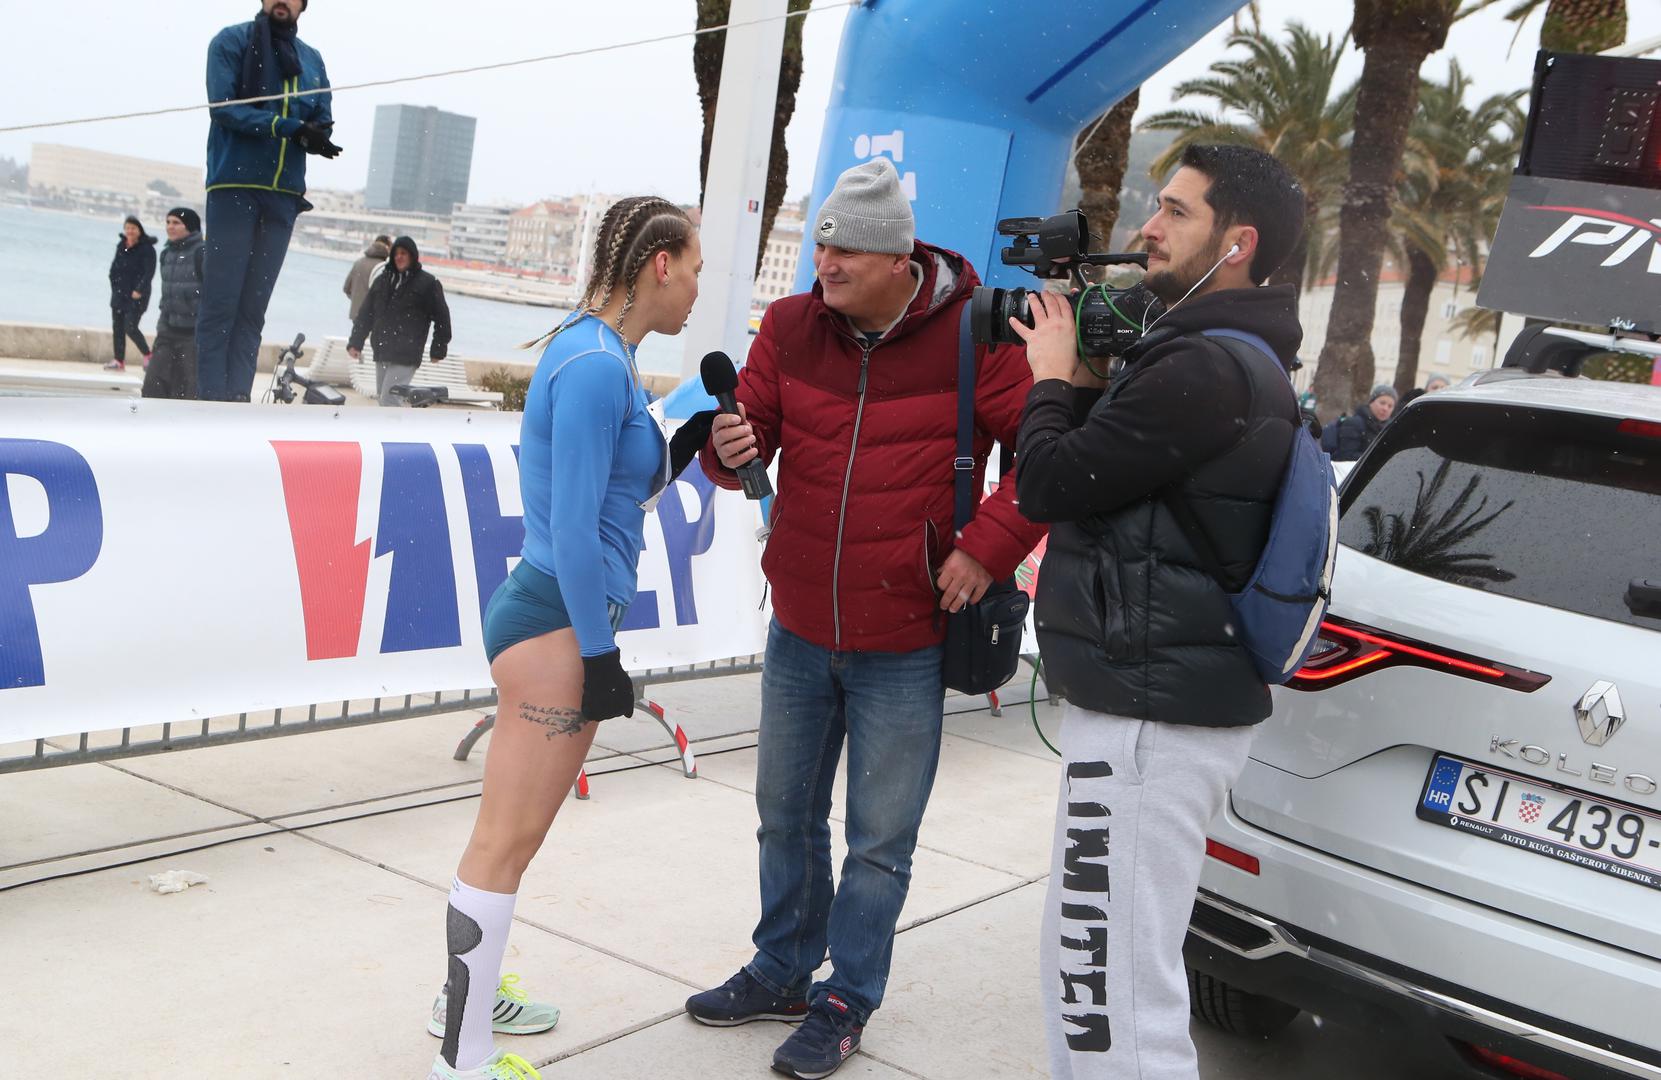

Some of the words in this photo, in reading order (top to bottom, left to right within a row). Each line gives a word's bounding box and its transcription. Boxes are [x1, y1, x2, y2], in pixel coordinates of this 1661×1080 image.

[1489, 734, 1657, 795] KOLEO
[1428, 789, 1450, 806] HR
[1457, 770, 1510, 822] ŠI
[1459, 819, 1493, 834] RENAULT
[1500, 832, 1527, 847] AUTO
[1528, 840, 1554, 856] KUĆA
[1556, 848, 1609, 871] GAŠPEROV
[1610, 862, 1653, 884] ŠIBENIK
[1060, 760, 1113, 1053] LIMITED
